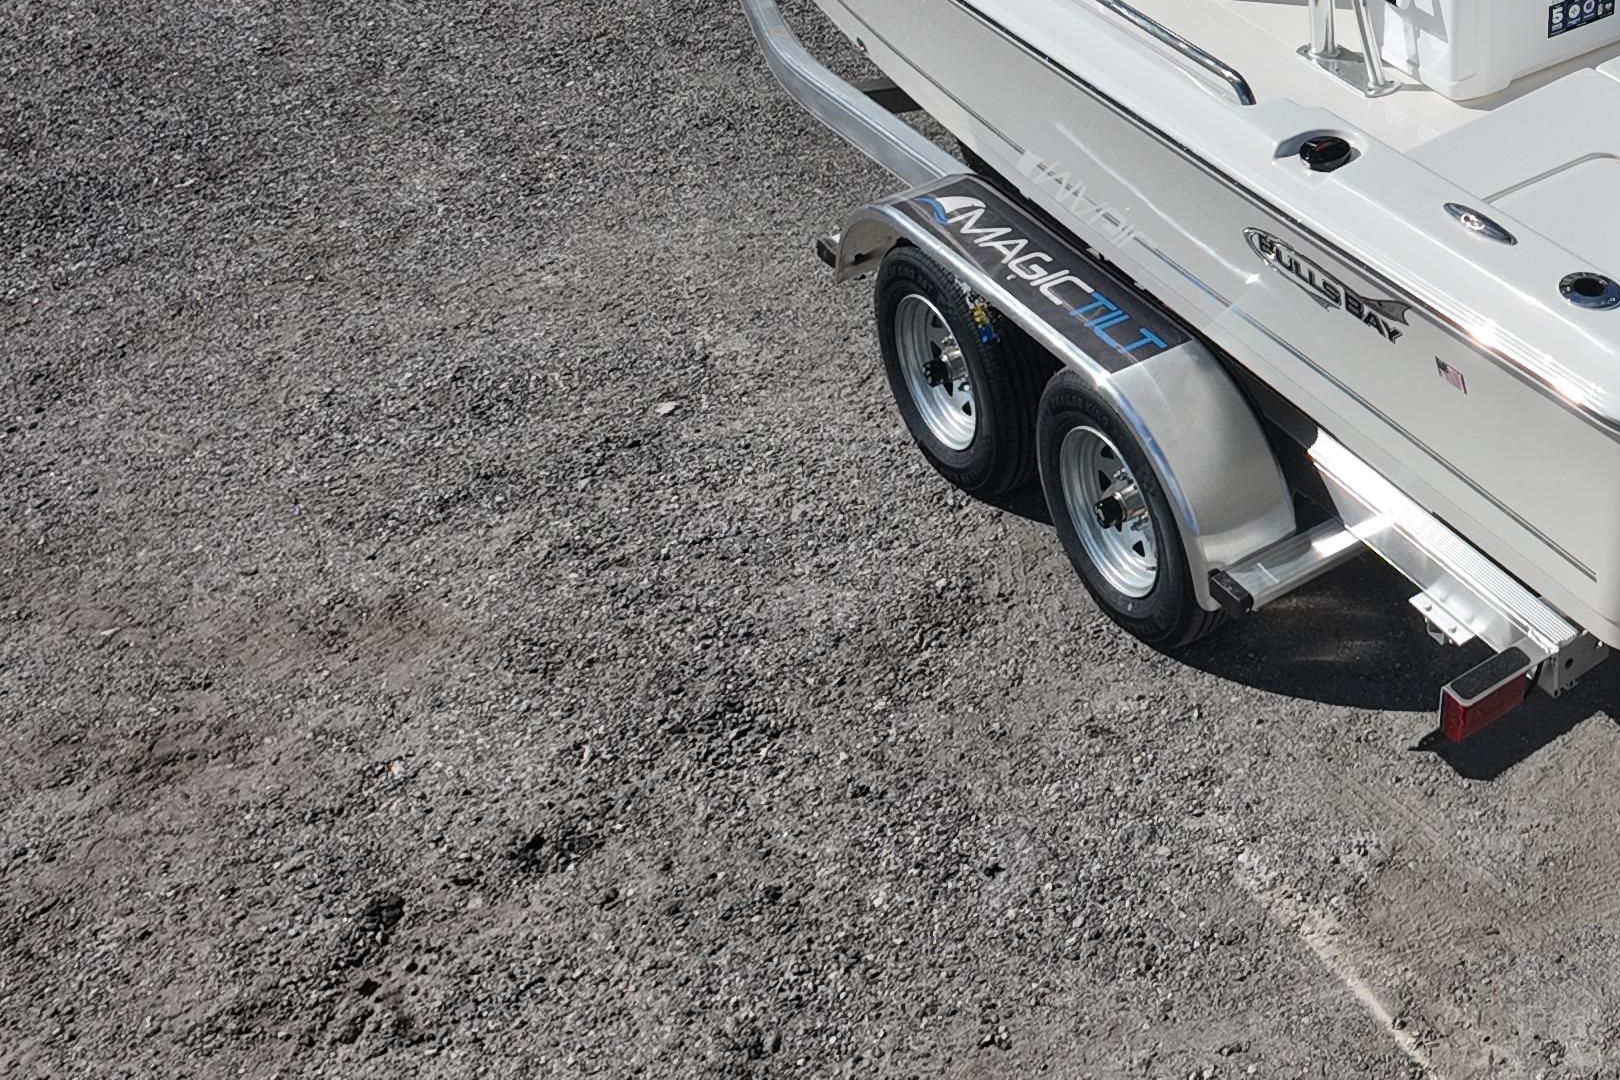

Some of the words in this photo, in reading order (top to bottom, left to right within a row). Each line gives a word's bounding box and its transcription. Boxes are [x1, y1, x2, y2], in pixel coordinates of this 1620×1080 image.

[1551, 6, 1564, 25] 5
[1257, 233, 1342, 307] BULLS
[1344, 290, 1404, 345] BAY
